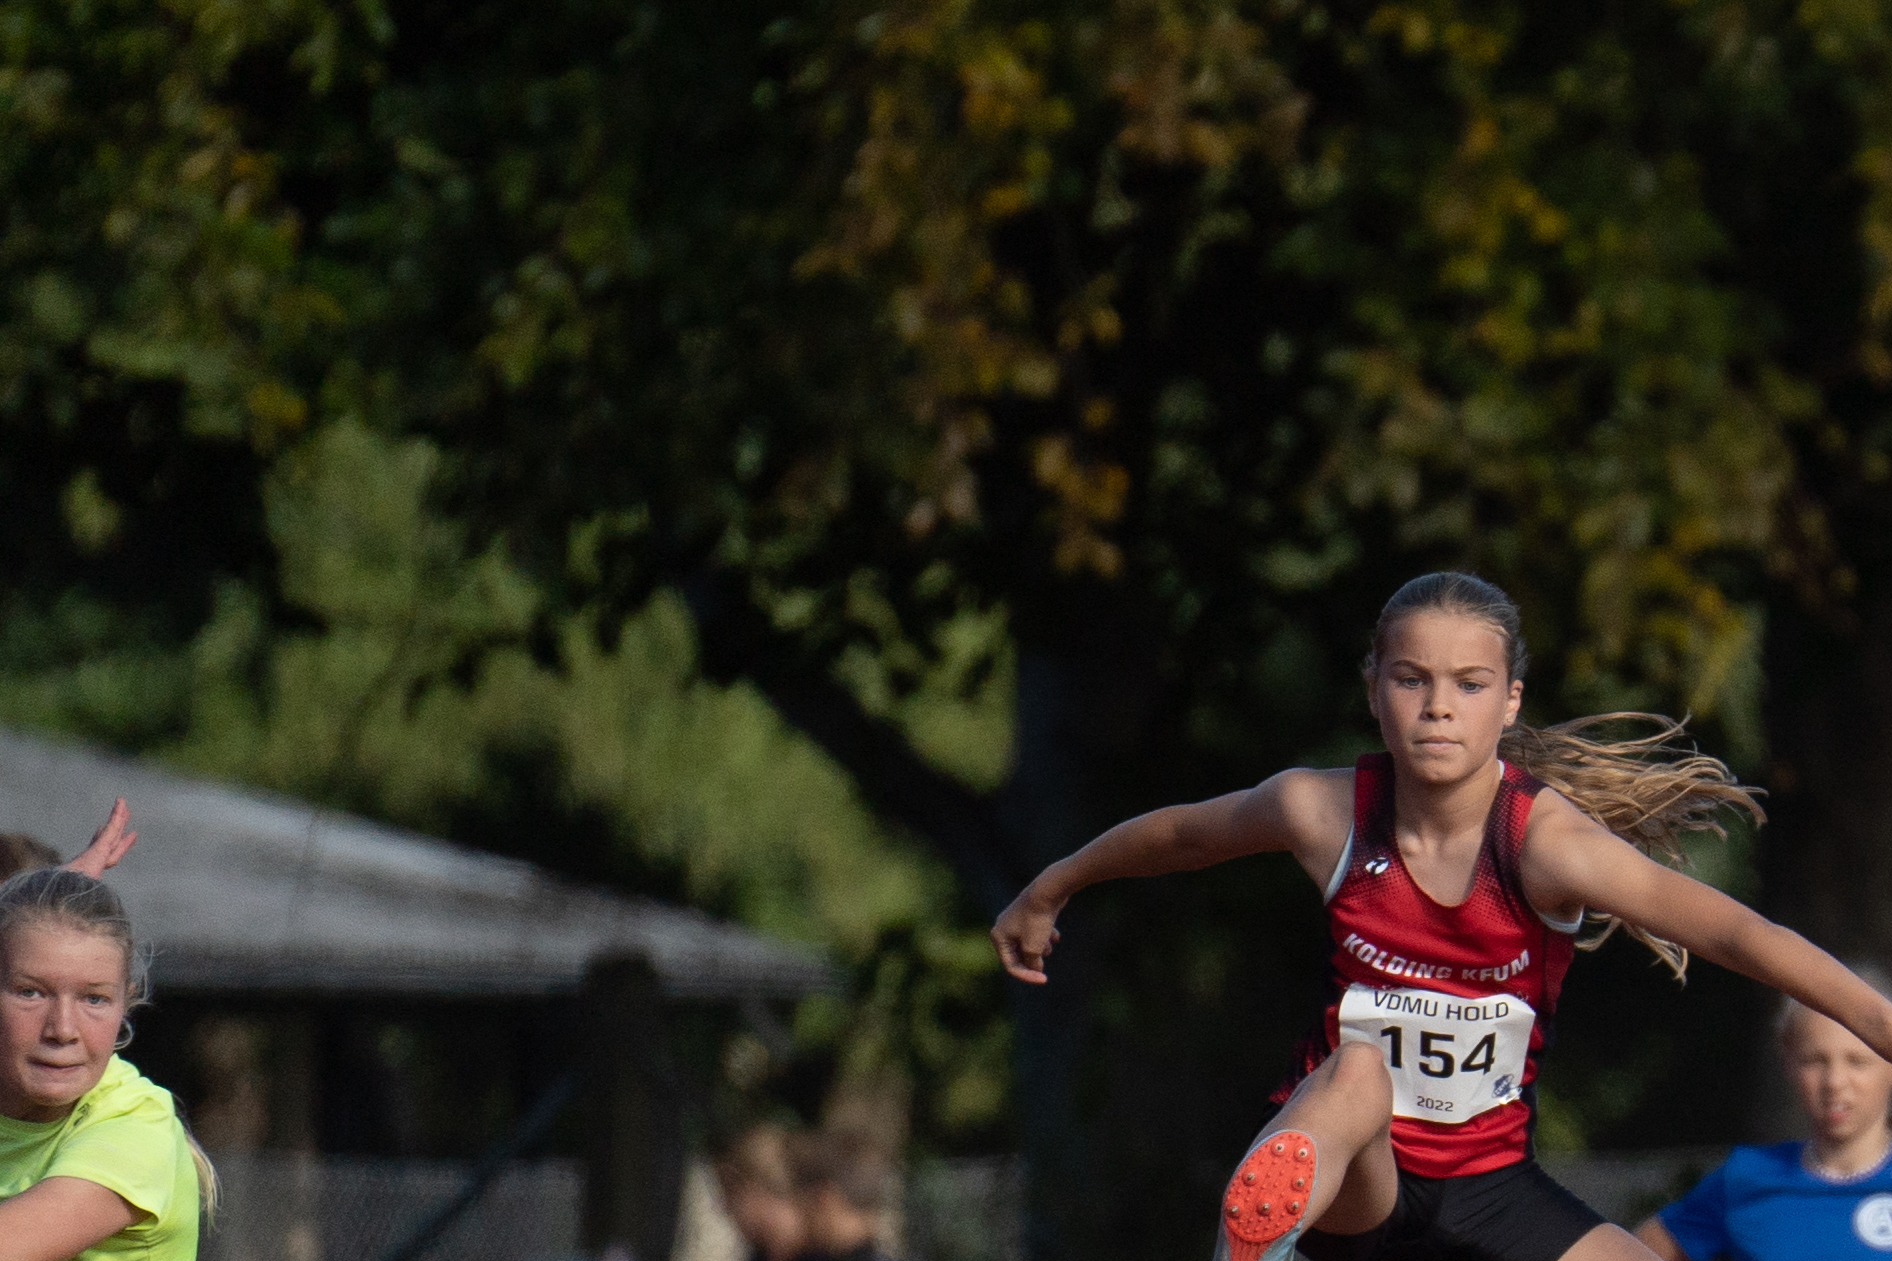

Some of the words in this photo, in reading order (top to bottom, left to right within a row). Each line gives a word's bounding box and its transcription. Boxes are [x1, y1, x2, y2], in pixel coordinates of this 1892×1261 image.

[1342, 933, 1454, 980] KOLDING
[1461, 948, 1531, 982] KFUM
[1373, 990, 1439, 1017] VDMU
[1446, 1001, 1509, 1021] HOLD
[1380, 1025, 1497, 1079] 154
[1416, 1095, 1454, 1112] 2022
